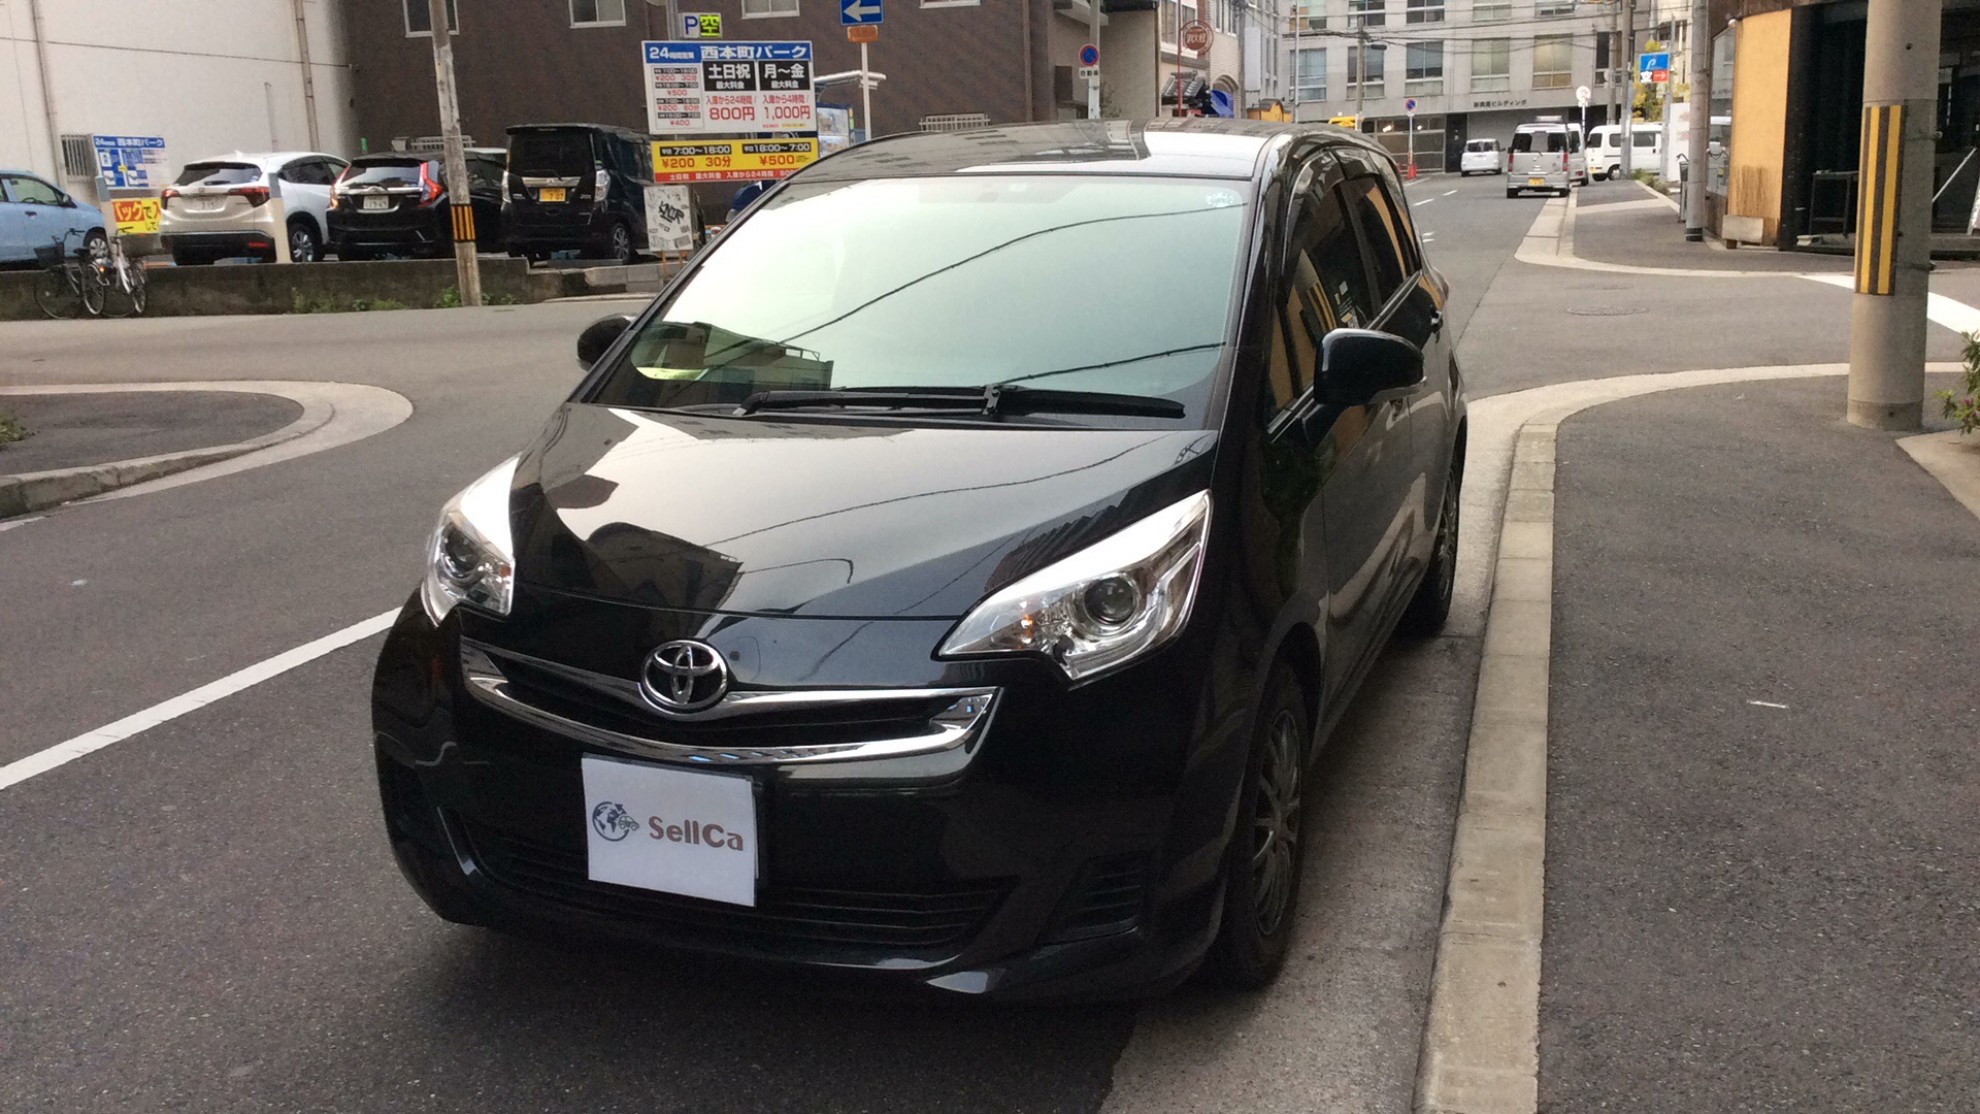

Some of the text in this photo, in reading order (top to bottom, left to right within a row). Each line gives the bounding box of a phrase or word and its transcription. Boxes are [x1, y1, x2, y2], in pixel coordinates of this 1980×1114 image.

[701, 45, 807, 60] 西本町パーク
[708, 63, 751, 79] 土日祝
[716, 80, 745, 90] 最大料金
[771, 80, 799, 89] 最大料金
[709, 106, 756, 121] 800円
[764, 105, 811, 120] 1,000円
[661, 156, 731, 169] ¥200 30分
[759, 154, 795, 166] ¥500
[648, 815, 744, 851] SellCa
